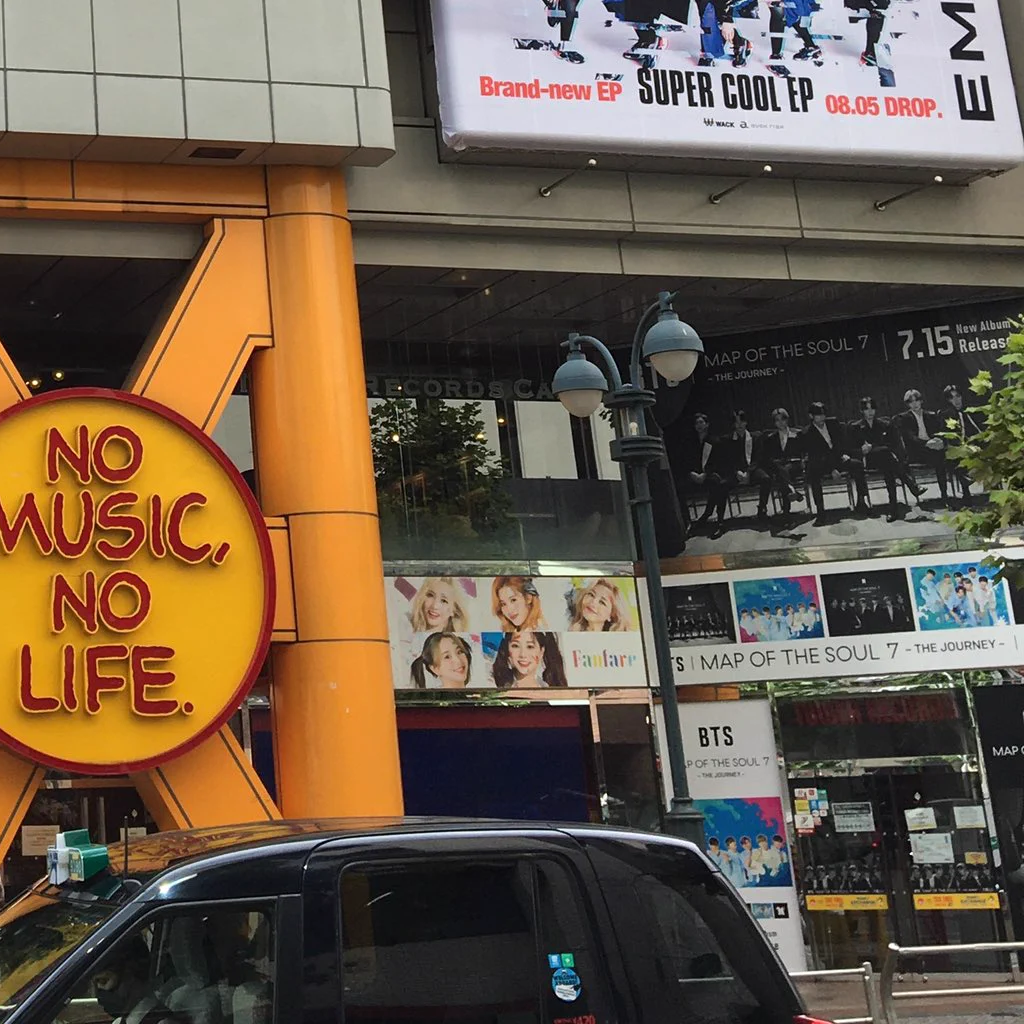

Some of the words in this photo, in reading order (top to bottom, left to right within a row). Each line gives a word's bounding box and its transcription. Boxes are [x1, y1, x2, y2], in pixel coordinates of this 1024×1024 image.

[480, 76, 591, 102] Brand-new
[597, 80, 623, 102] EP
[638, 68, 715, 108] SUPER
[722, 75, 782, 112] COOL
[787, 76, 814, 113] EP
[825, 94, 880, 115] 08.05
[885, 96, 943, 118] DROP.
[956, 323, 977, 334] New
[980, 320, 1011, 332] Album
[704, 349, 741, 367] MAP
[744, 346, 768, 361] OF
[771, 343, 804, 359] THE
[807, 337, 853, 355] SOUL
[858, 334, 869, 349] 7
[897, 325, 953, 361] 7.15
[959, 337, 1007, 353] Releas
[46, 425, 144, 485] NO
[51, 570, 151, 634] NO
[701, 652, 744, 671] MAP
[750, 650, 776, 667] OF
[781, 647, 820, 666] THE
[825, 644, 880, 663] SOUL
[887, 642, 899, 659] 7
[915, 643, 937, 654] THE
[940, 639, 996, 652] JOURNEY
[18, 644, 195, 717] LIFE.
[698, 725, 734, 747] BTS
[695, 758, 708, 768] OF
[711, 757, 730, 768] THE
[733, 757, 760, 767] SOUL
[763, 756, 770, 766] 7
[992, 746, 1019, 757] MAP
